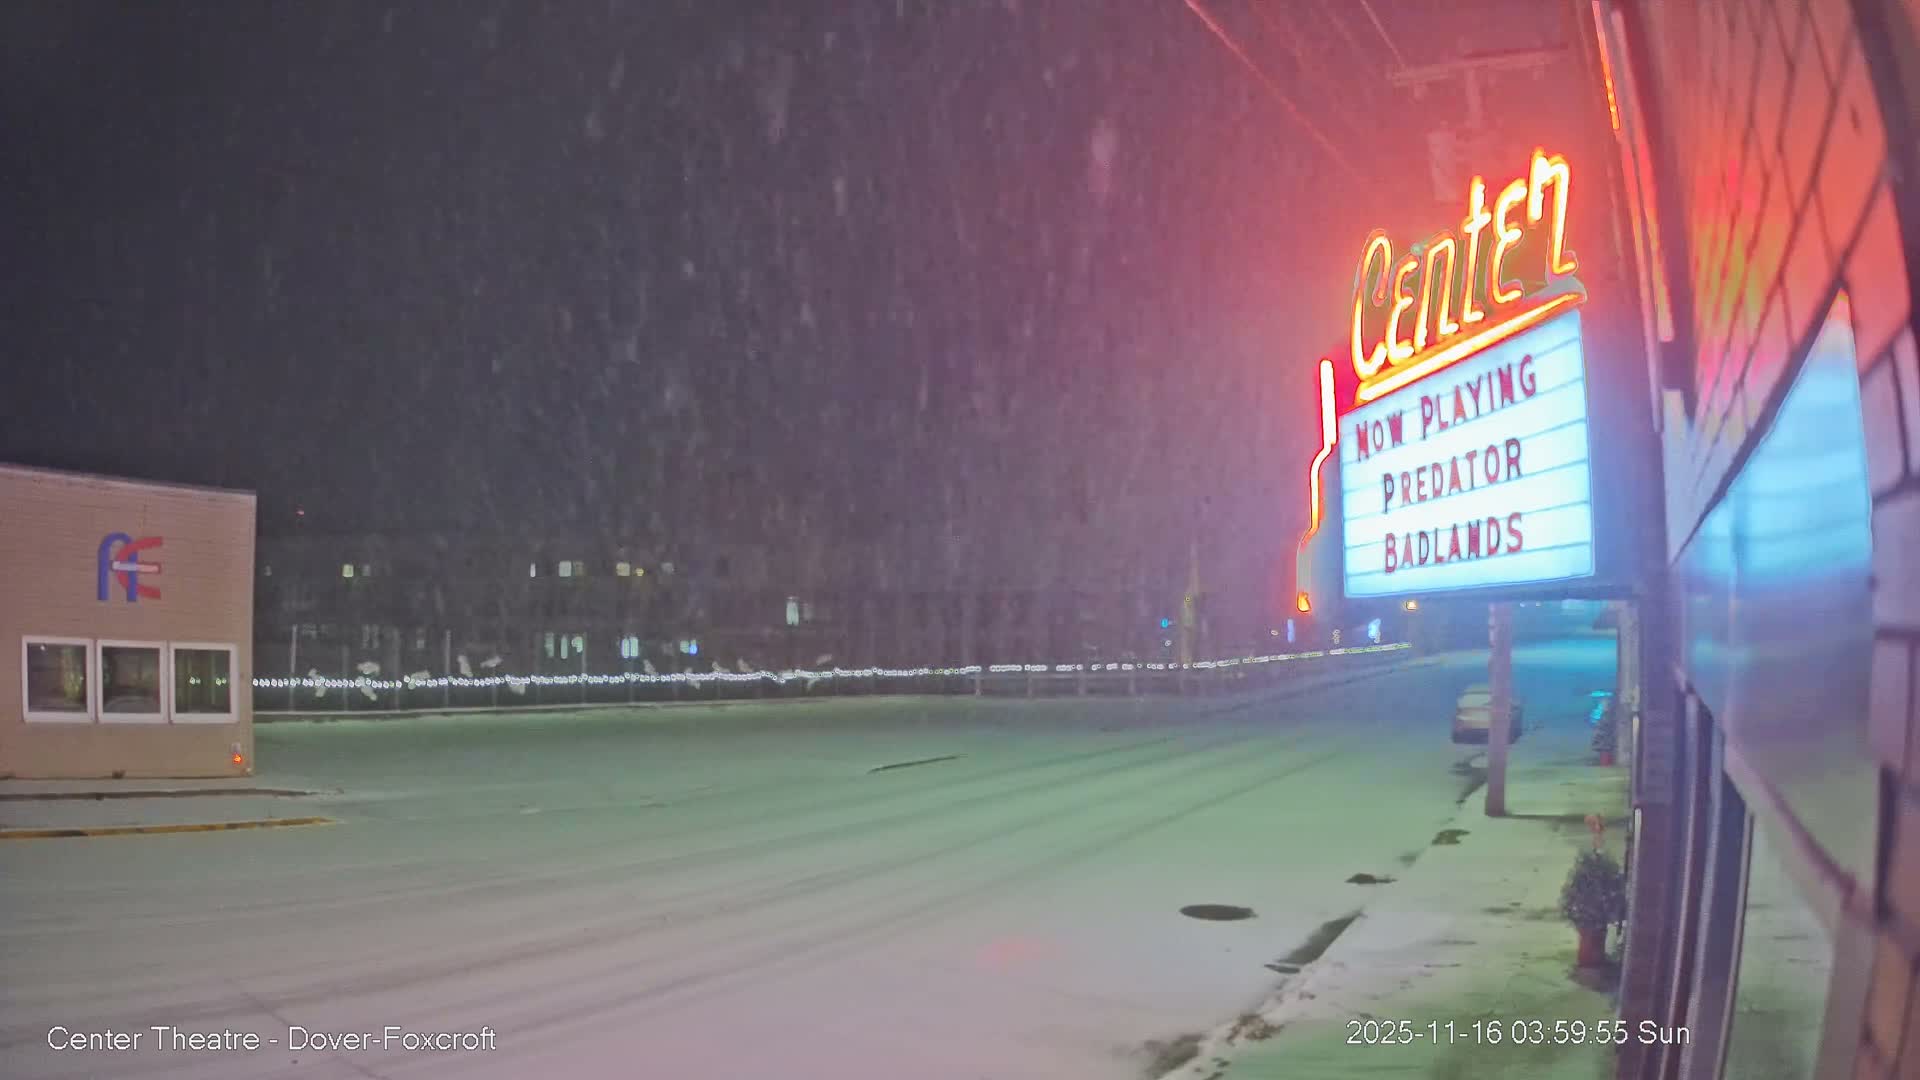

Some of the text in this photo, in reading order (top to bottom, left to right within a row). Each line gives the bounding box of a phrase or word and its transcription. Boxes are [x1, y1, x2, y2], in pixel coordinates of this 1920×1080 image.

[1350, 148, 1578, 380] Center
[1355, 354, 1537, 463] NOW PLAYING
[1382, 438, 1523, 514] PREDATOR
[1384, 512, 1525, 574] BADLANDS
